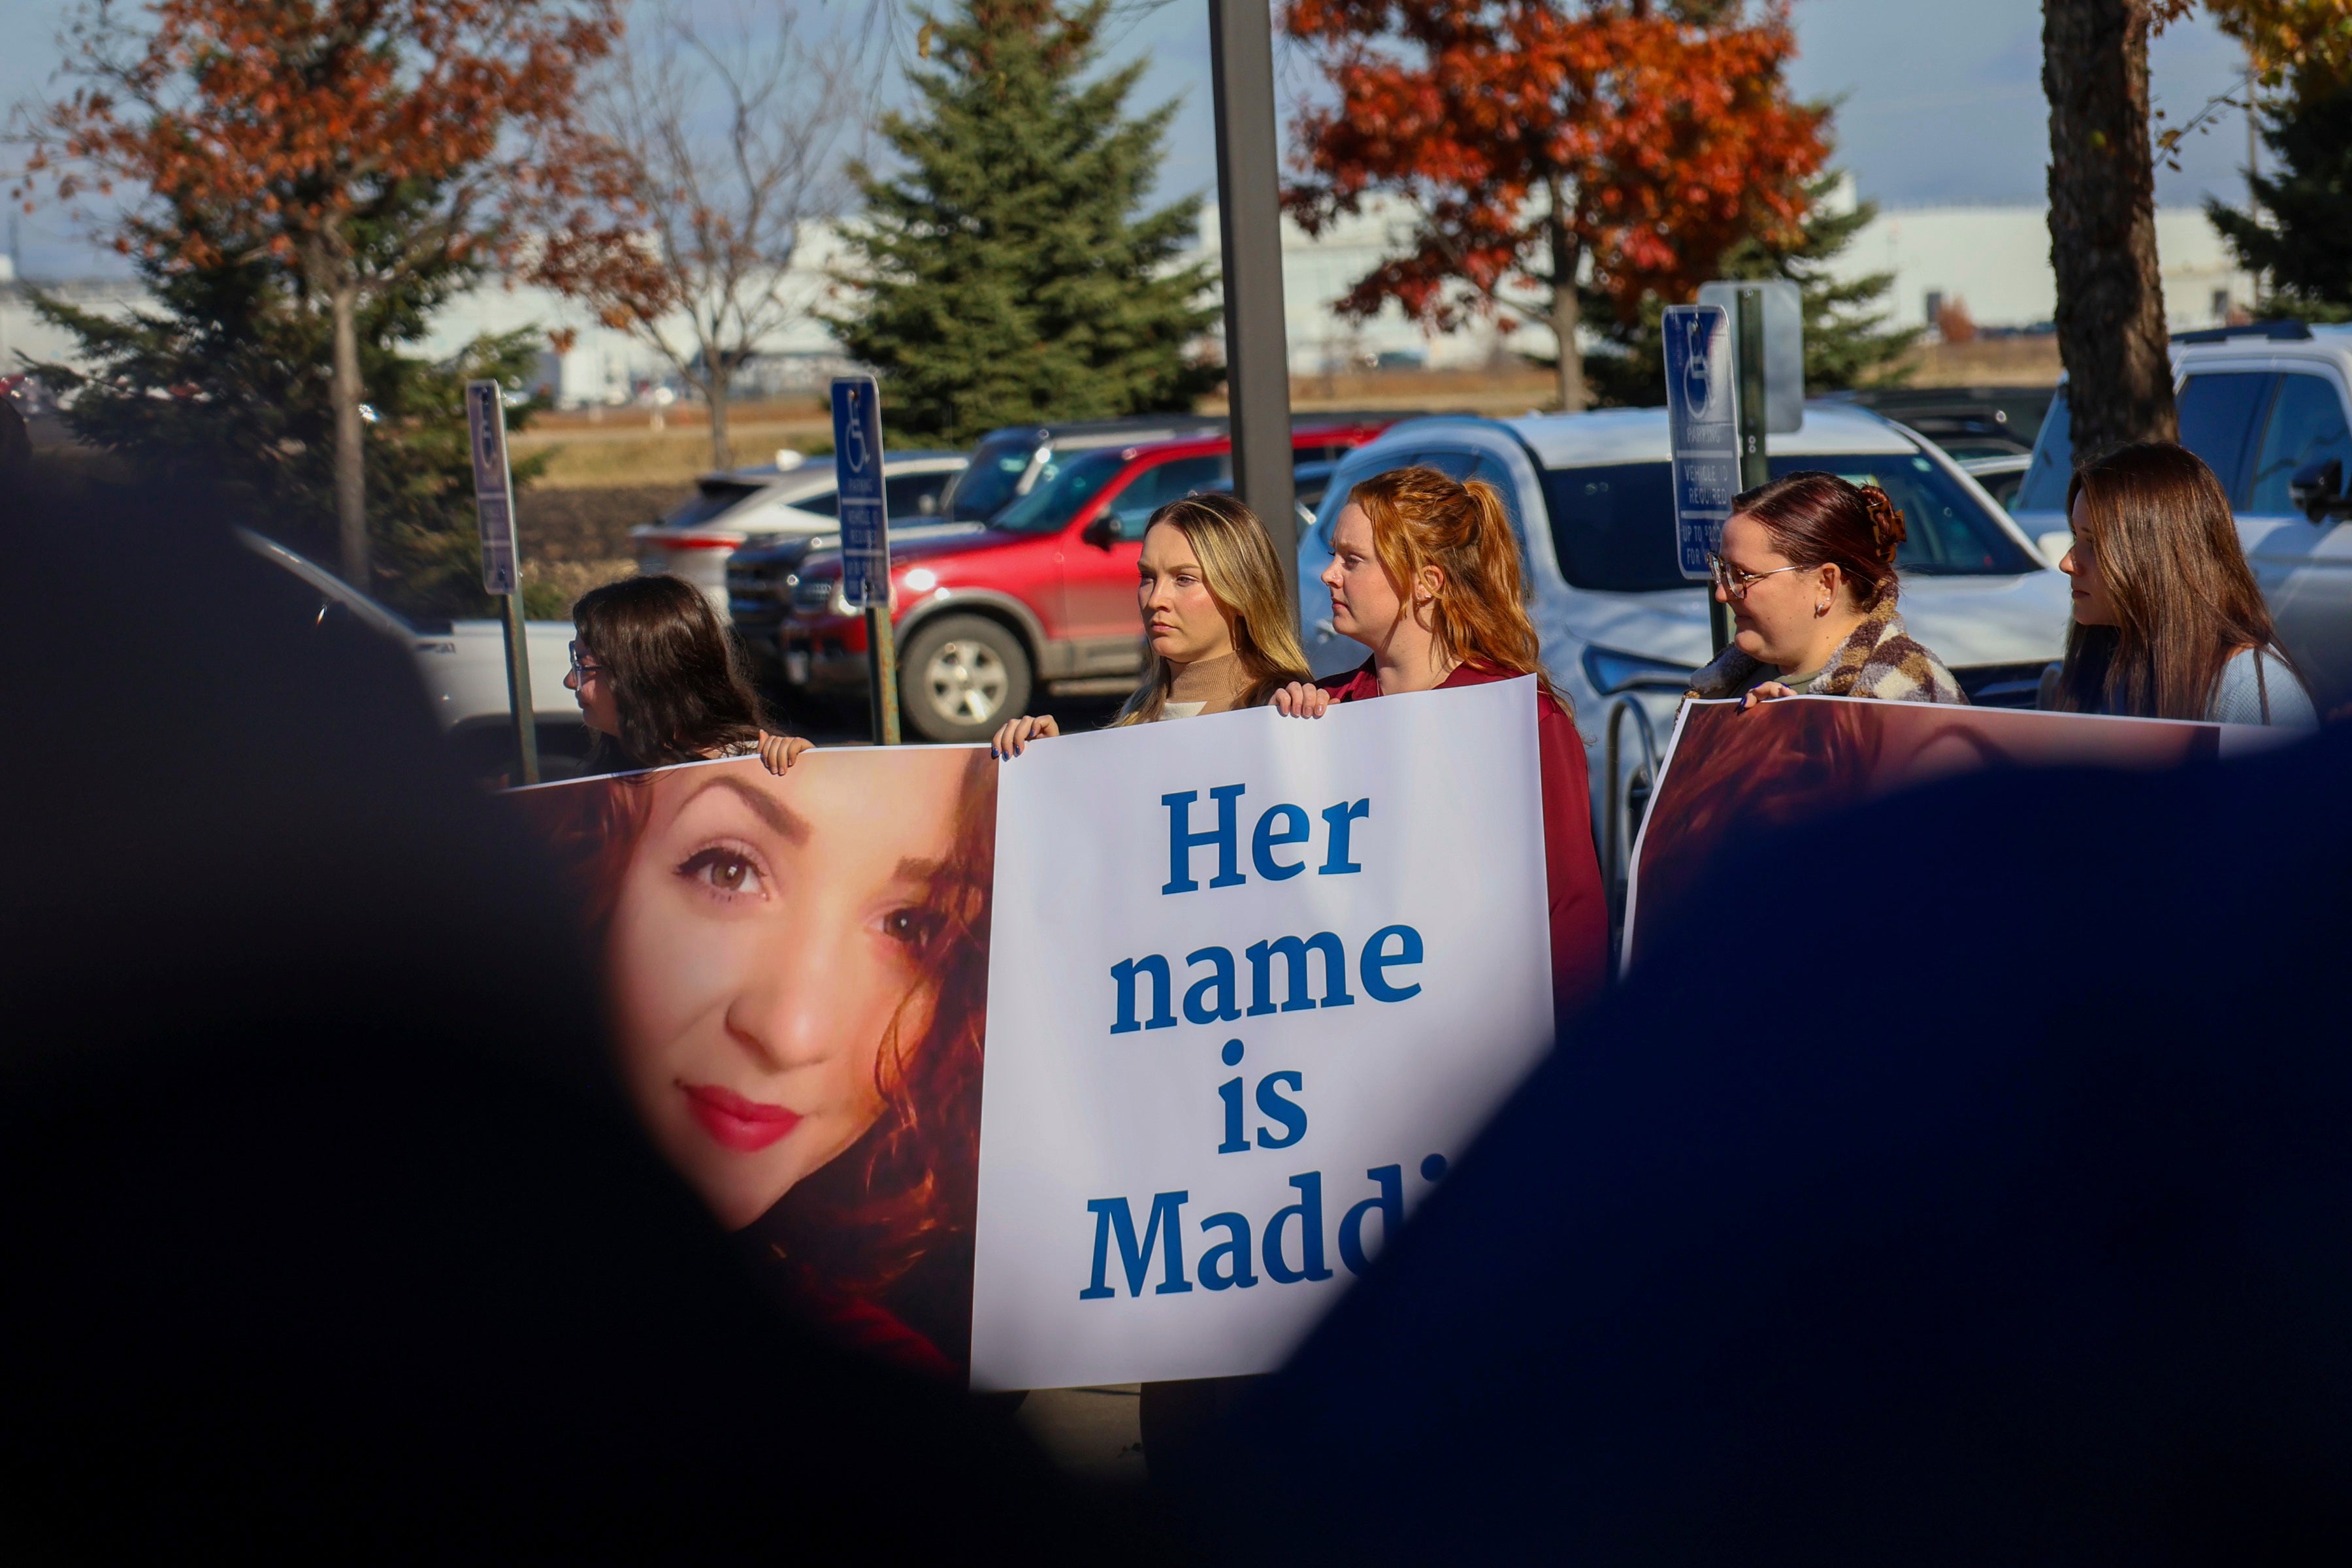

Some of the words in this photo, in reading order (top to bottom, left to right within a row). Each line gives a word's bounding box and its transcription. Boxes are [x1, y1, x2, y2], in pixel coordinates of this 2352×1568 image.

[1686, 427, 1720, 443] PARKING
[1684, 465, 1716, 482] VEHICLE
[1689, 487, 1727, 504] REQUIRED
[1682, 525, 1692, 542] UP
[1693, 525, 1703, 542] TO
[1686, 547, 1701, 565] FOR
[1161, 783, 1370, 896] Her
[1110, 924, 1424, 1035] name
[1218, 1037, 1309, 1154] is
[1079, 1152, 1448, 1301] Madd
